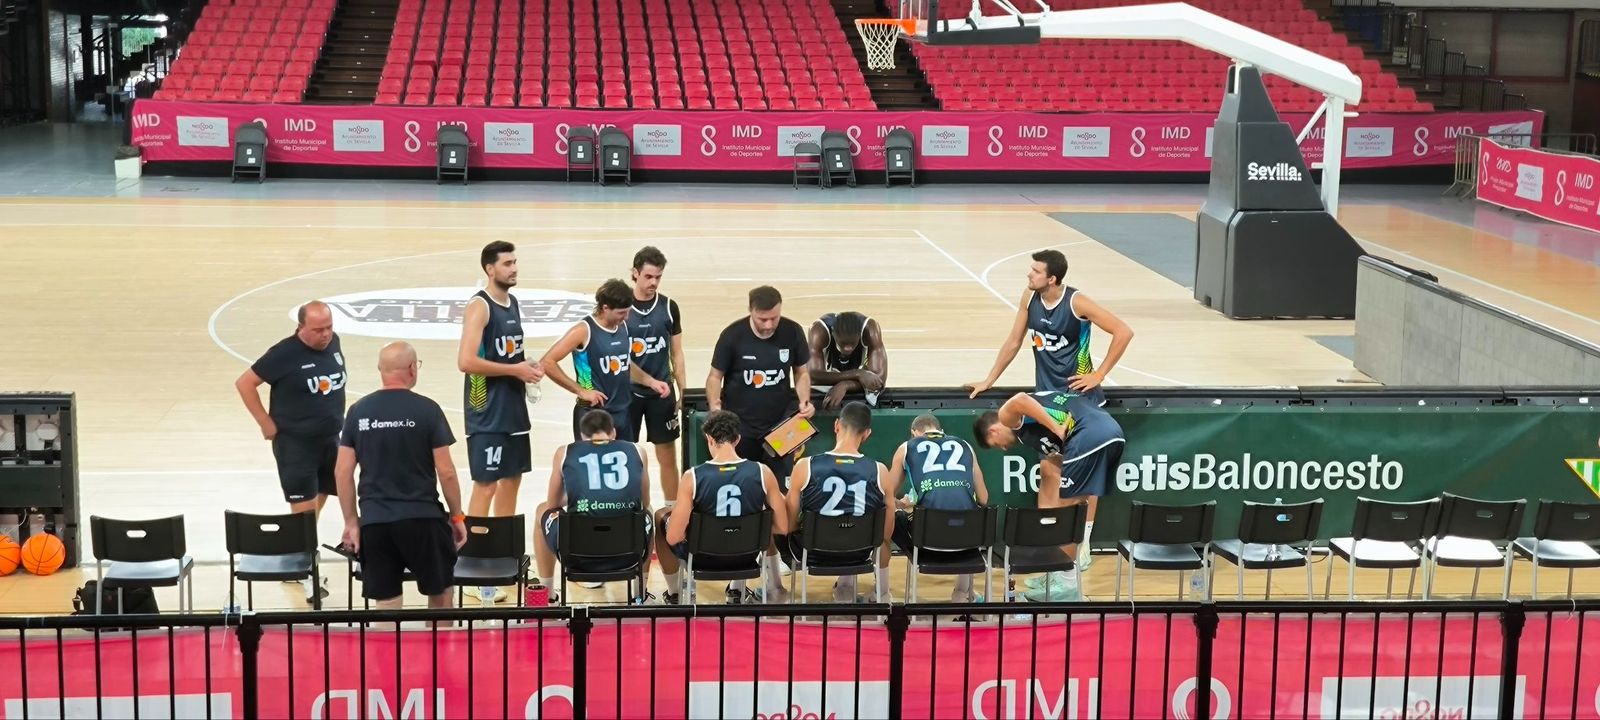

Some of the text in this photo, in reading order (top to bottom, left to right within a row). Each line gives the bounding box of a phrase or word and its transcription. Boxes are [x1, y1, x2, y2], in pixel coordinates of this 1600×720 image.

[284, 118, 316, 132] IMD
[732, 125, 762, 138] IMD
[1018, 125, 1048, 139] IMD
[1161, 126, 1191, 139] IMD
[275, 138, 326, 148] Instituto Municipal
[744, 145, 771, 154] Municipal
[1008, 145, 1056, 154] Instituto Municipal
[1151, 146, 1199, 155] Instituto Municipal
[1575, 172, 1594, 190] IMD
[495, 335, 524, 358] UDE
[630, 336, 666, 357] DEA
[743, 368, 786, 389] UDEA
[371, 418, 416, 429] damex.io
[484, 446, 503, 465] 14
[917, 440, 966, 474] 22
[579, 451, 629, 490] 13
[716, 484, 742, 517] 6
[819, 475, 867, 517] 21
